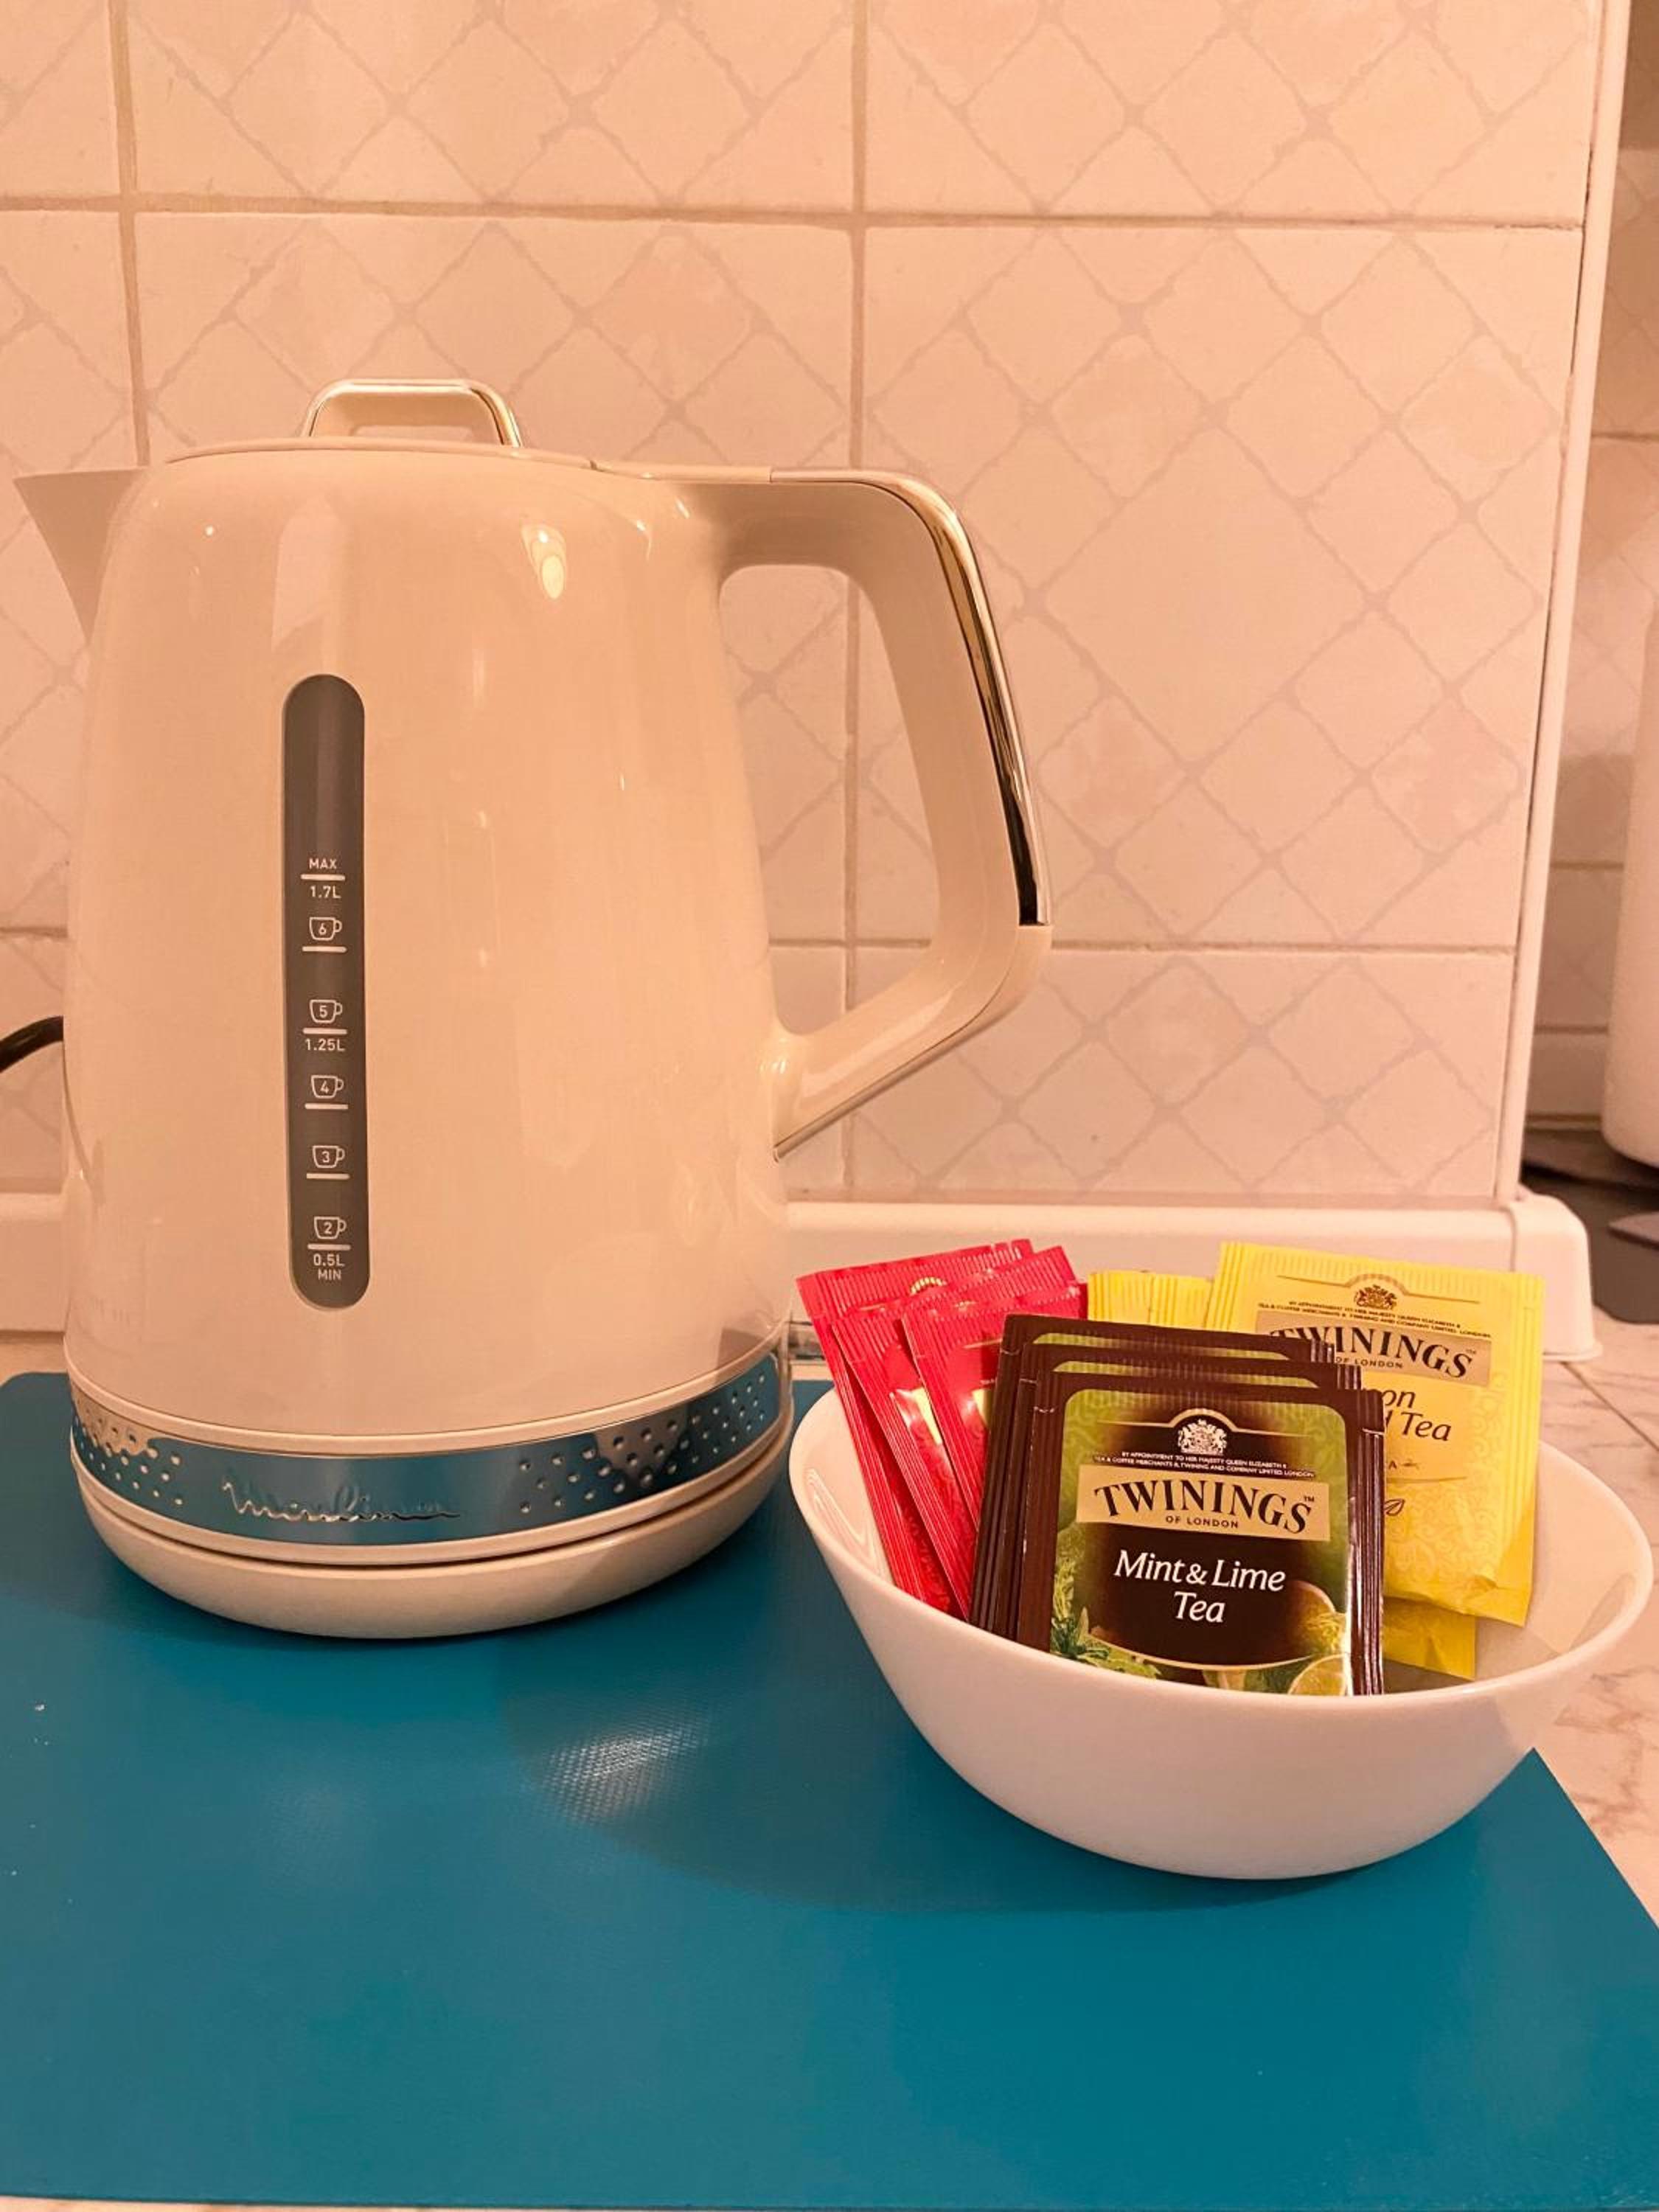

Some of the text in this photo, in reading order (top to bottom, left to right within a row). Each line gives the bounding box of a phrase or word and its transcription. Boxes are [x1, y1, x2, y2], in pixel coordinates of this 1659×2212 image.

[309, 858, 337, 870] MAX
[310, 886, 341, 898] 1.7L
[318, 923, 327, 935] 6
[319, 1005, 327, 1018] 5
[305, 1038, 345, 1051] 1.25L
[320, 1081, 330, 1093] 4
[322, 1151, 330, 1163] 3
[324, 1222, 332, 1234] 2
[313, 1253, 344, 1266] 0.5L
[318, 1270, 341, 1280] MIN
[1354, 1358, 1403, 1369] LONDON
[1401, 1411, 1451, 1441] Tea
[1094, 1479, 1312, 1534] TWININGS
[1187, 1517, 1238, 1528] LONDON
[1113, 1549, 1183, 1583] Mint
[1212, 1559, 1286, 1592] Lime
[1172, 1591, 1225, 1623] Tea
